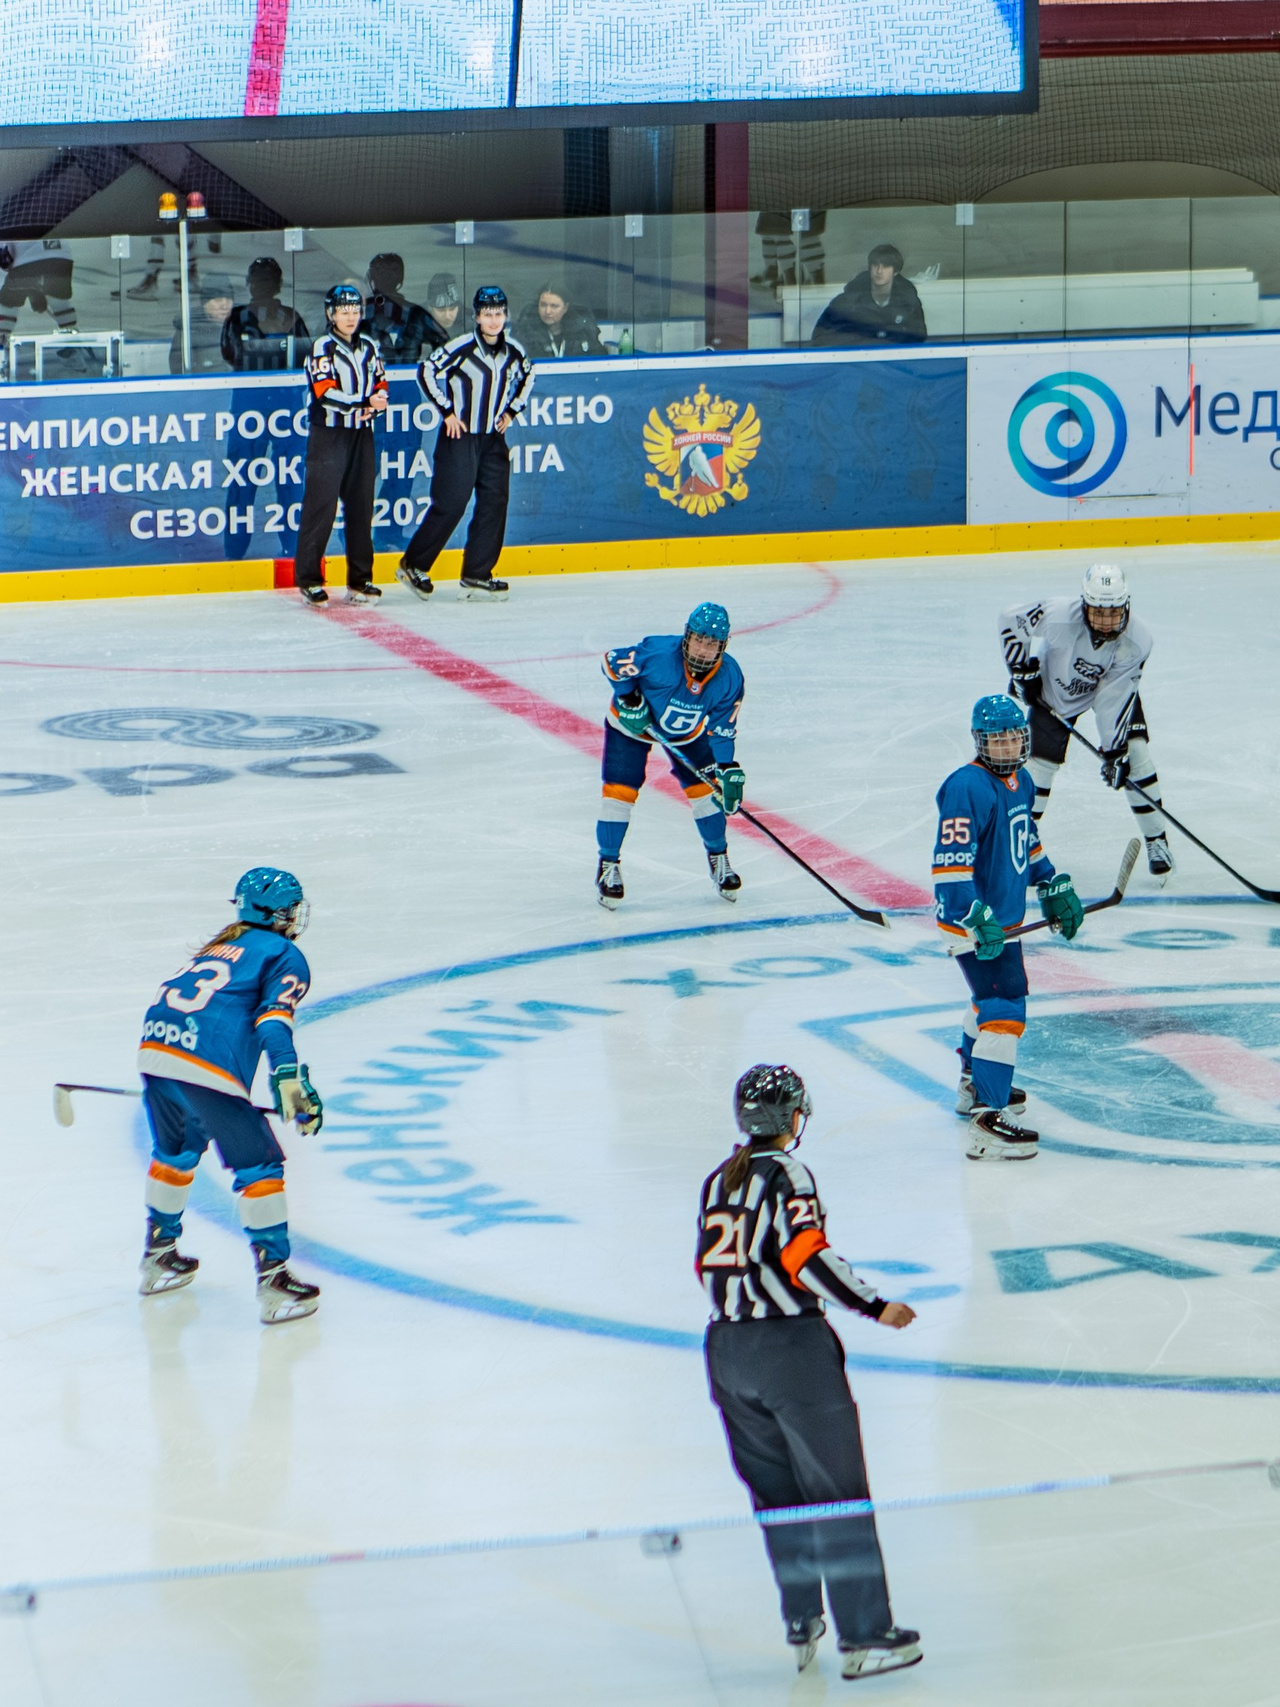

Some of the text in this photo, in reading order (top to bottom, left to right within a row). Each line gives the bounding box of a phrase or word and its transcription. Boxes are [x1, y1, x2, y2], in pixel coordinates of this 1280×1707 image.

[311, 356, 331, 375] 16
[430, 346, 450, 370] 81
[215, 408, 310, 441] РОСС
[21, 459, 213, 498] ЖЕНСКАЯ
[508, 443, 565, 474] ИГА
[130, 505, 255, 540] СЕЗОН
[1101, 577, 1111, 586] 18
[941, 817, 972, 845] 55
[933, 851, 977, 867] врор
[787, 1198, 821, 1227] 21
[702, 1212, 746, 1268] 21
